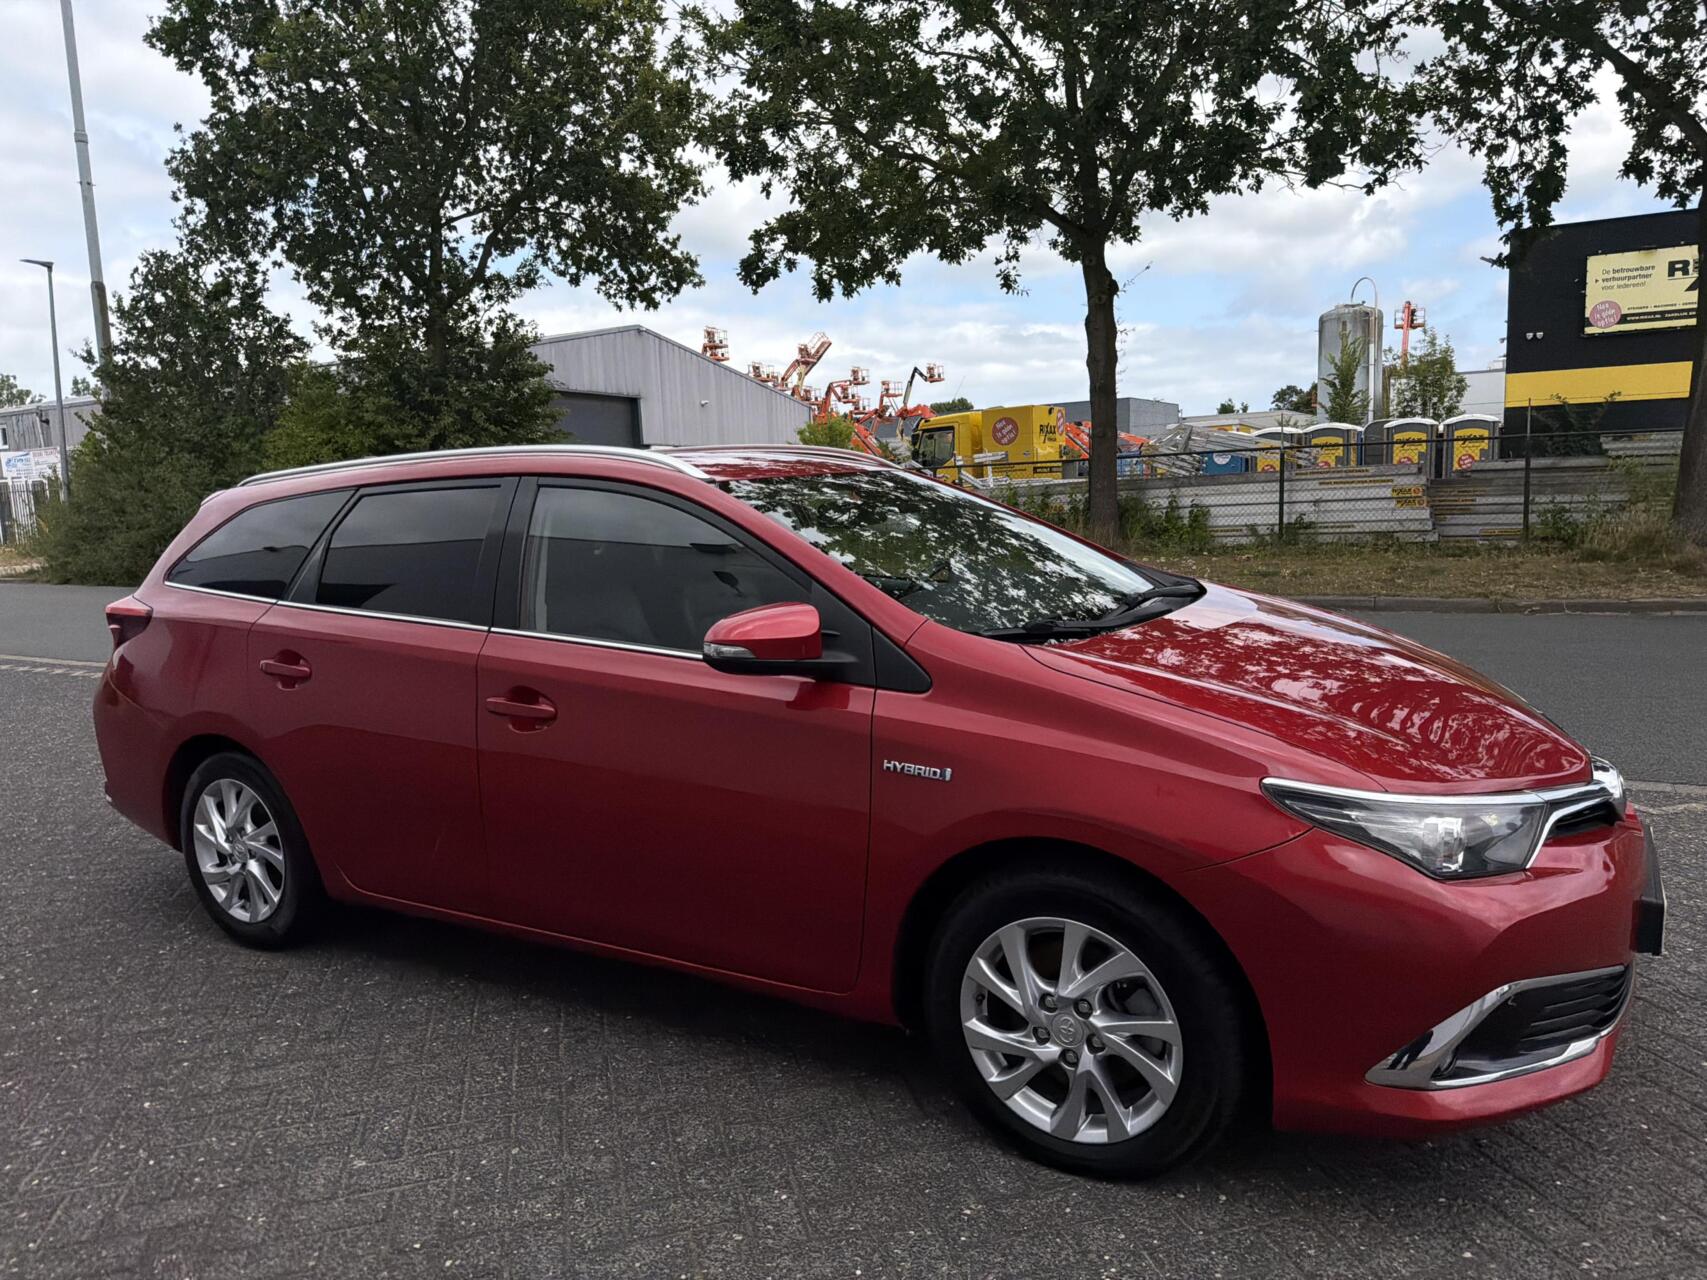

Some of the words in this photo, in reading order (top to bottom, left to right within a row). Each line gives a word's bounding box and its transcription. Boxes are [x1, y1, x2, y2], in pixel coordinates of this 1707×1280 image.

[1612, 265, 1656, 274] betrouwbare
[1601, 273, 1653, 283] verhuurpartner
[1617, 281, 1647, 289] iedereen!
[1040, 422, 1056, 443] RIXAX
[883, 760, 941, 779] HYBRID
